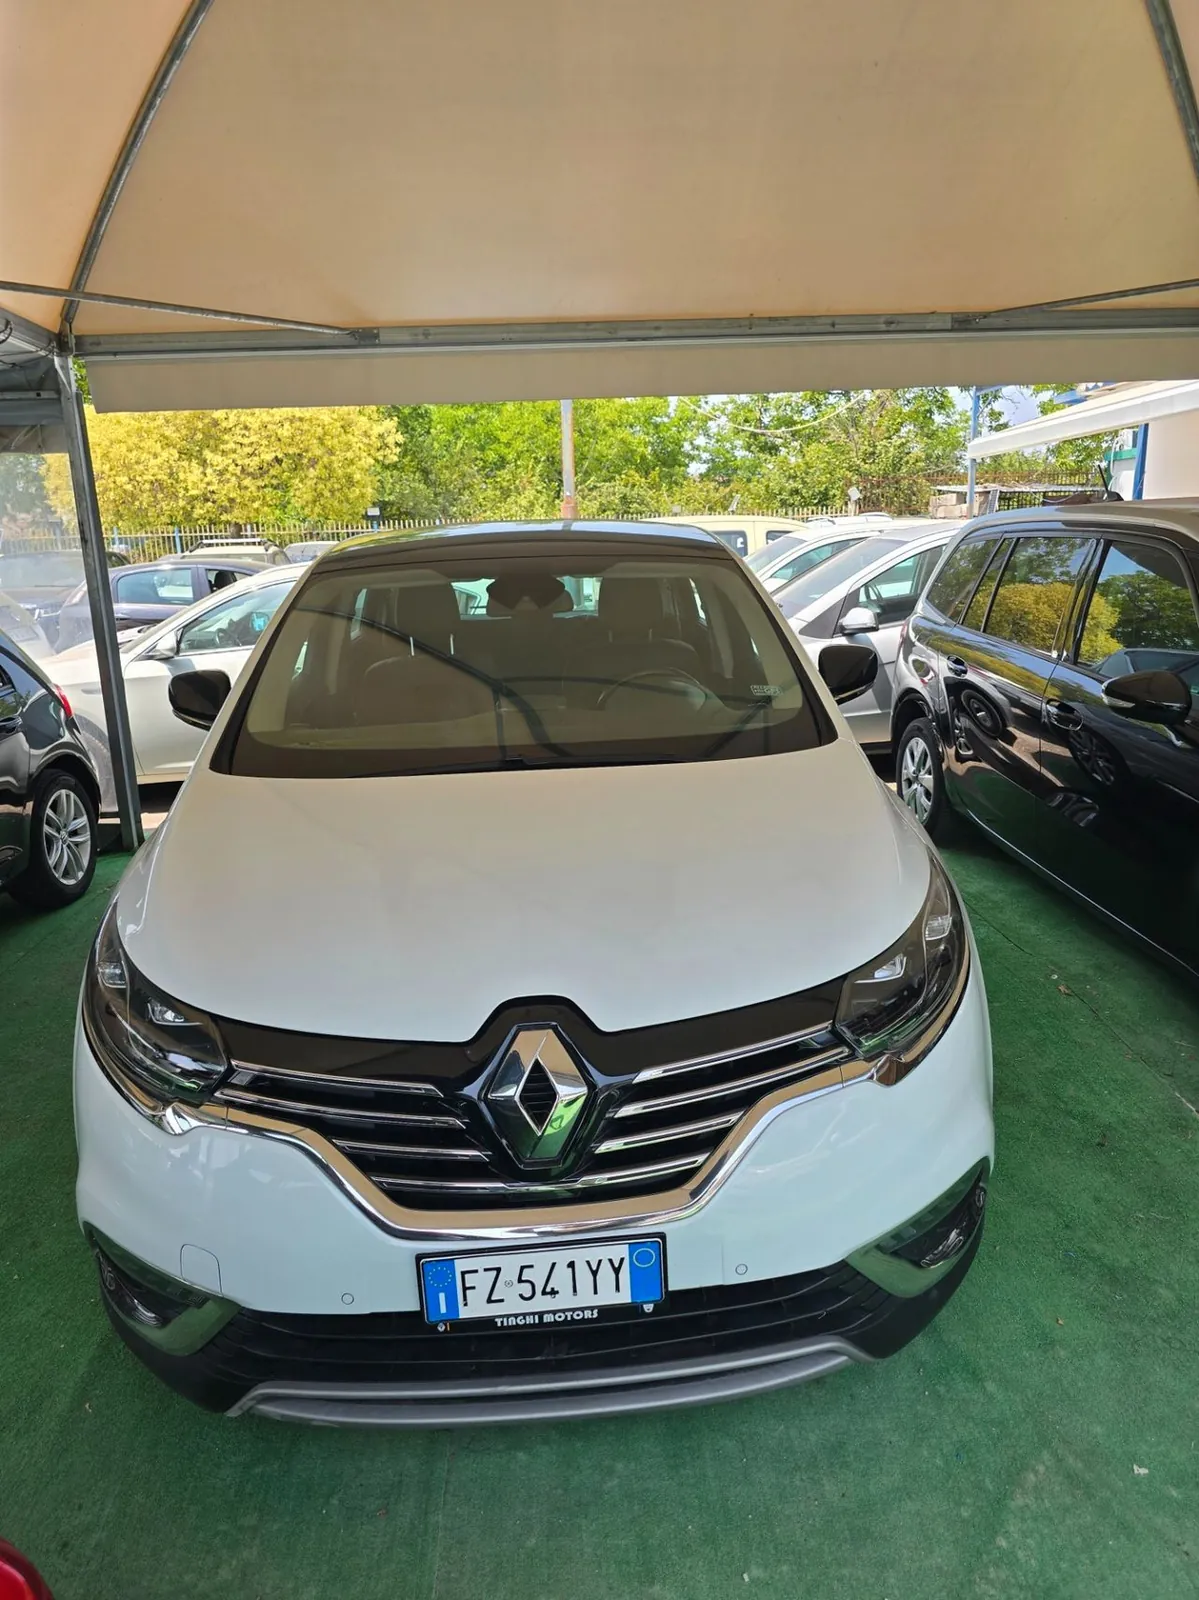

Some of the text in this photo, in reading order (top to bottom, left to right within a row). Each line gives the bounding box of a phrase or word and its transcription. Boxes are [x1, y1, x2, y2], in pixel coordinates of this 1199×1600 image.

[438, 1292, 447, 1314] I
[495, 1309, 599, 1327] TINGHI MOTORS
